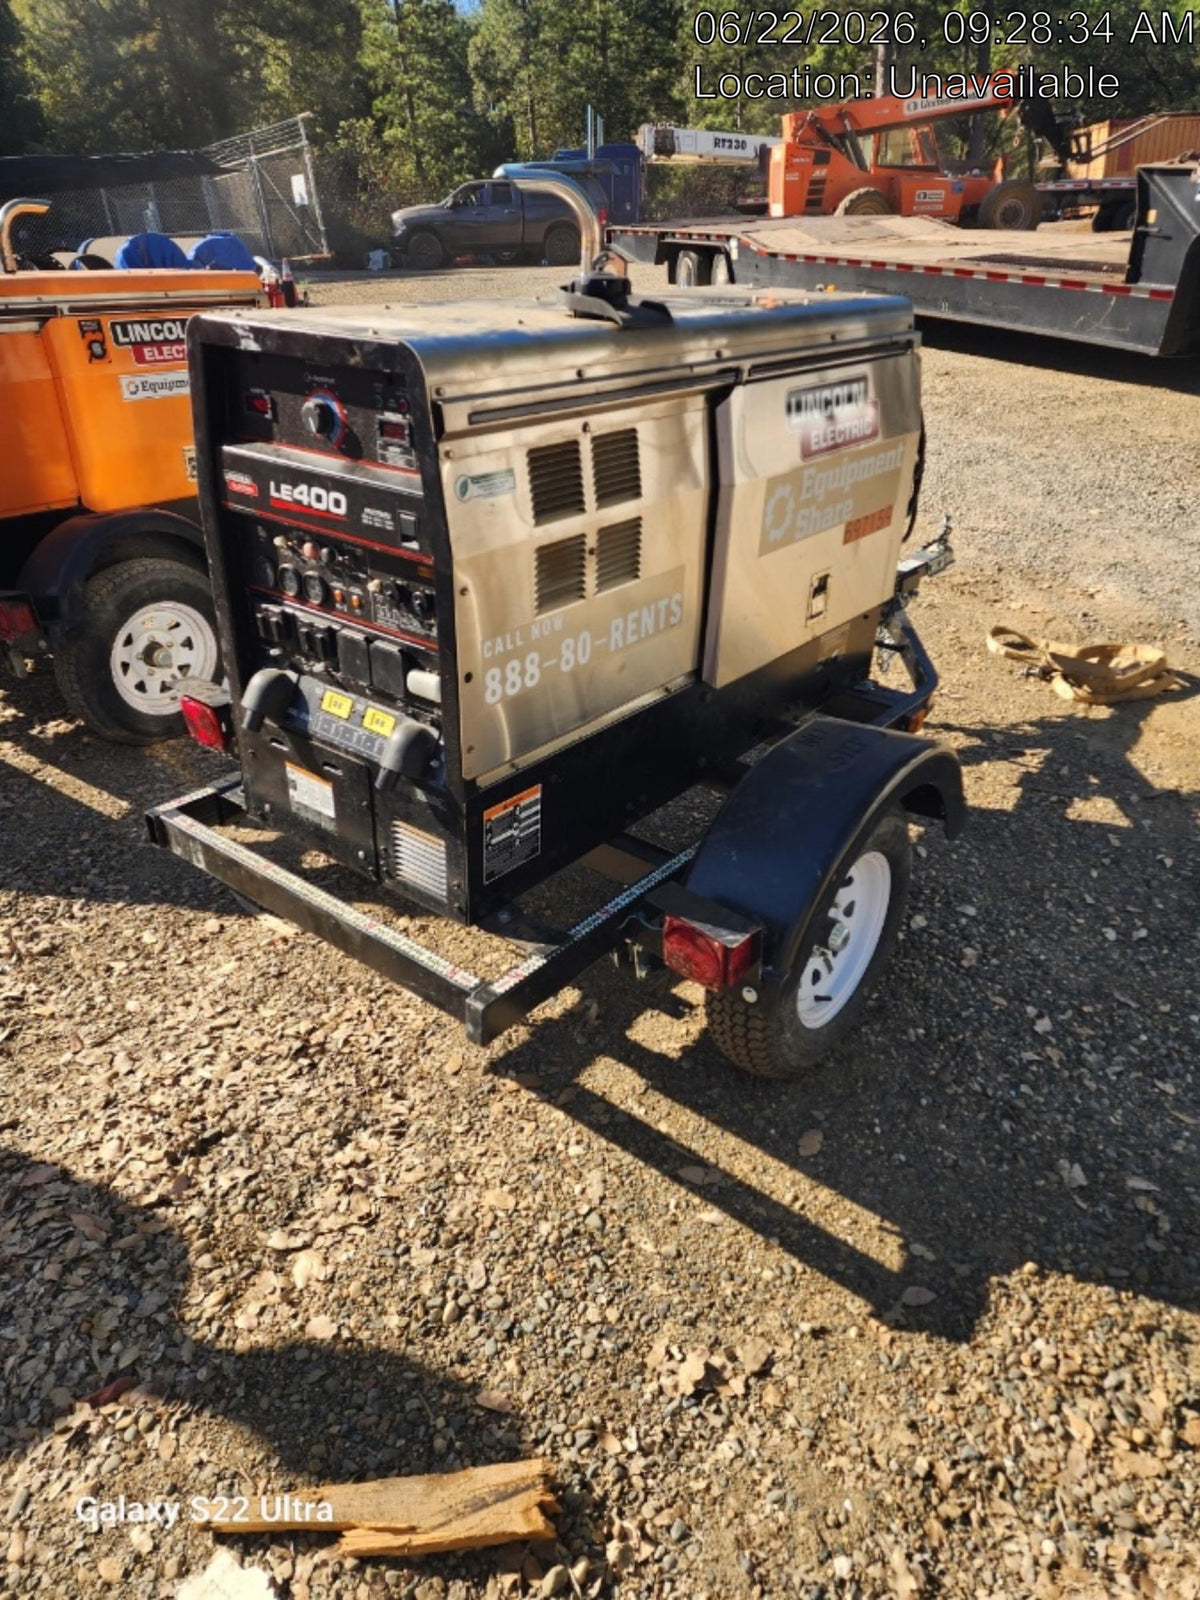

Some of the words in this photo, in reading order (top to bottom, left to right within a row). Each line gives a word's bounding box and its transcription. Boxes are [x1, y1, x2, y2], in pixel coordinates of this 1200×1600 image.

[714, 137, 747, 150] RT230
[115, 321, 186, 342] LINCOL
[141, 380, 189, 393] Equipm
[791, 382, 867, 428] LINCOLN
[812, 418, 873, 450] ELECTRIC
[802, 442, 904, 501] Equipment
[269, 481, 347, 516] LE400
[795, 500, 854, 542] Share
[483, 631, 525, 658] CALL
[531, 615, 564, 641] NOW
[484, 592, 682, 705] 888-80-RENTS
